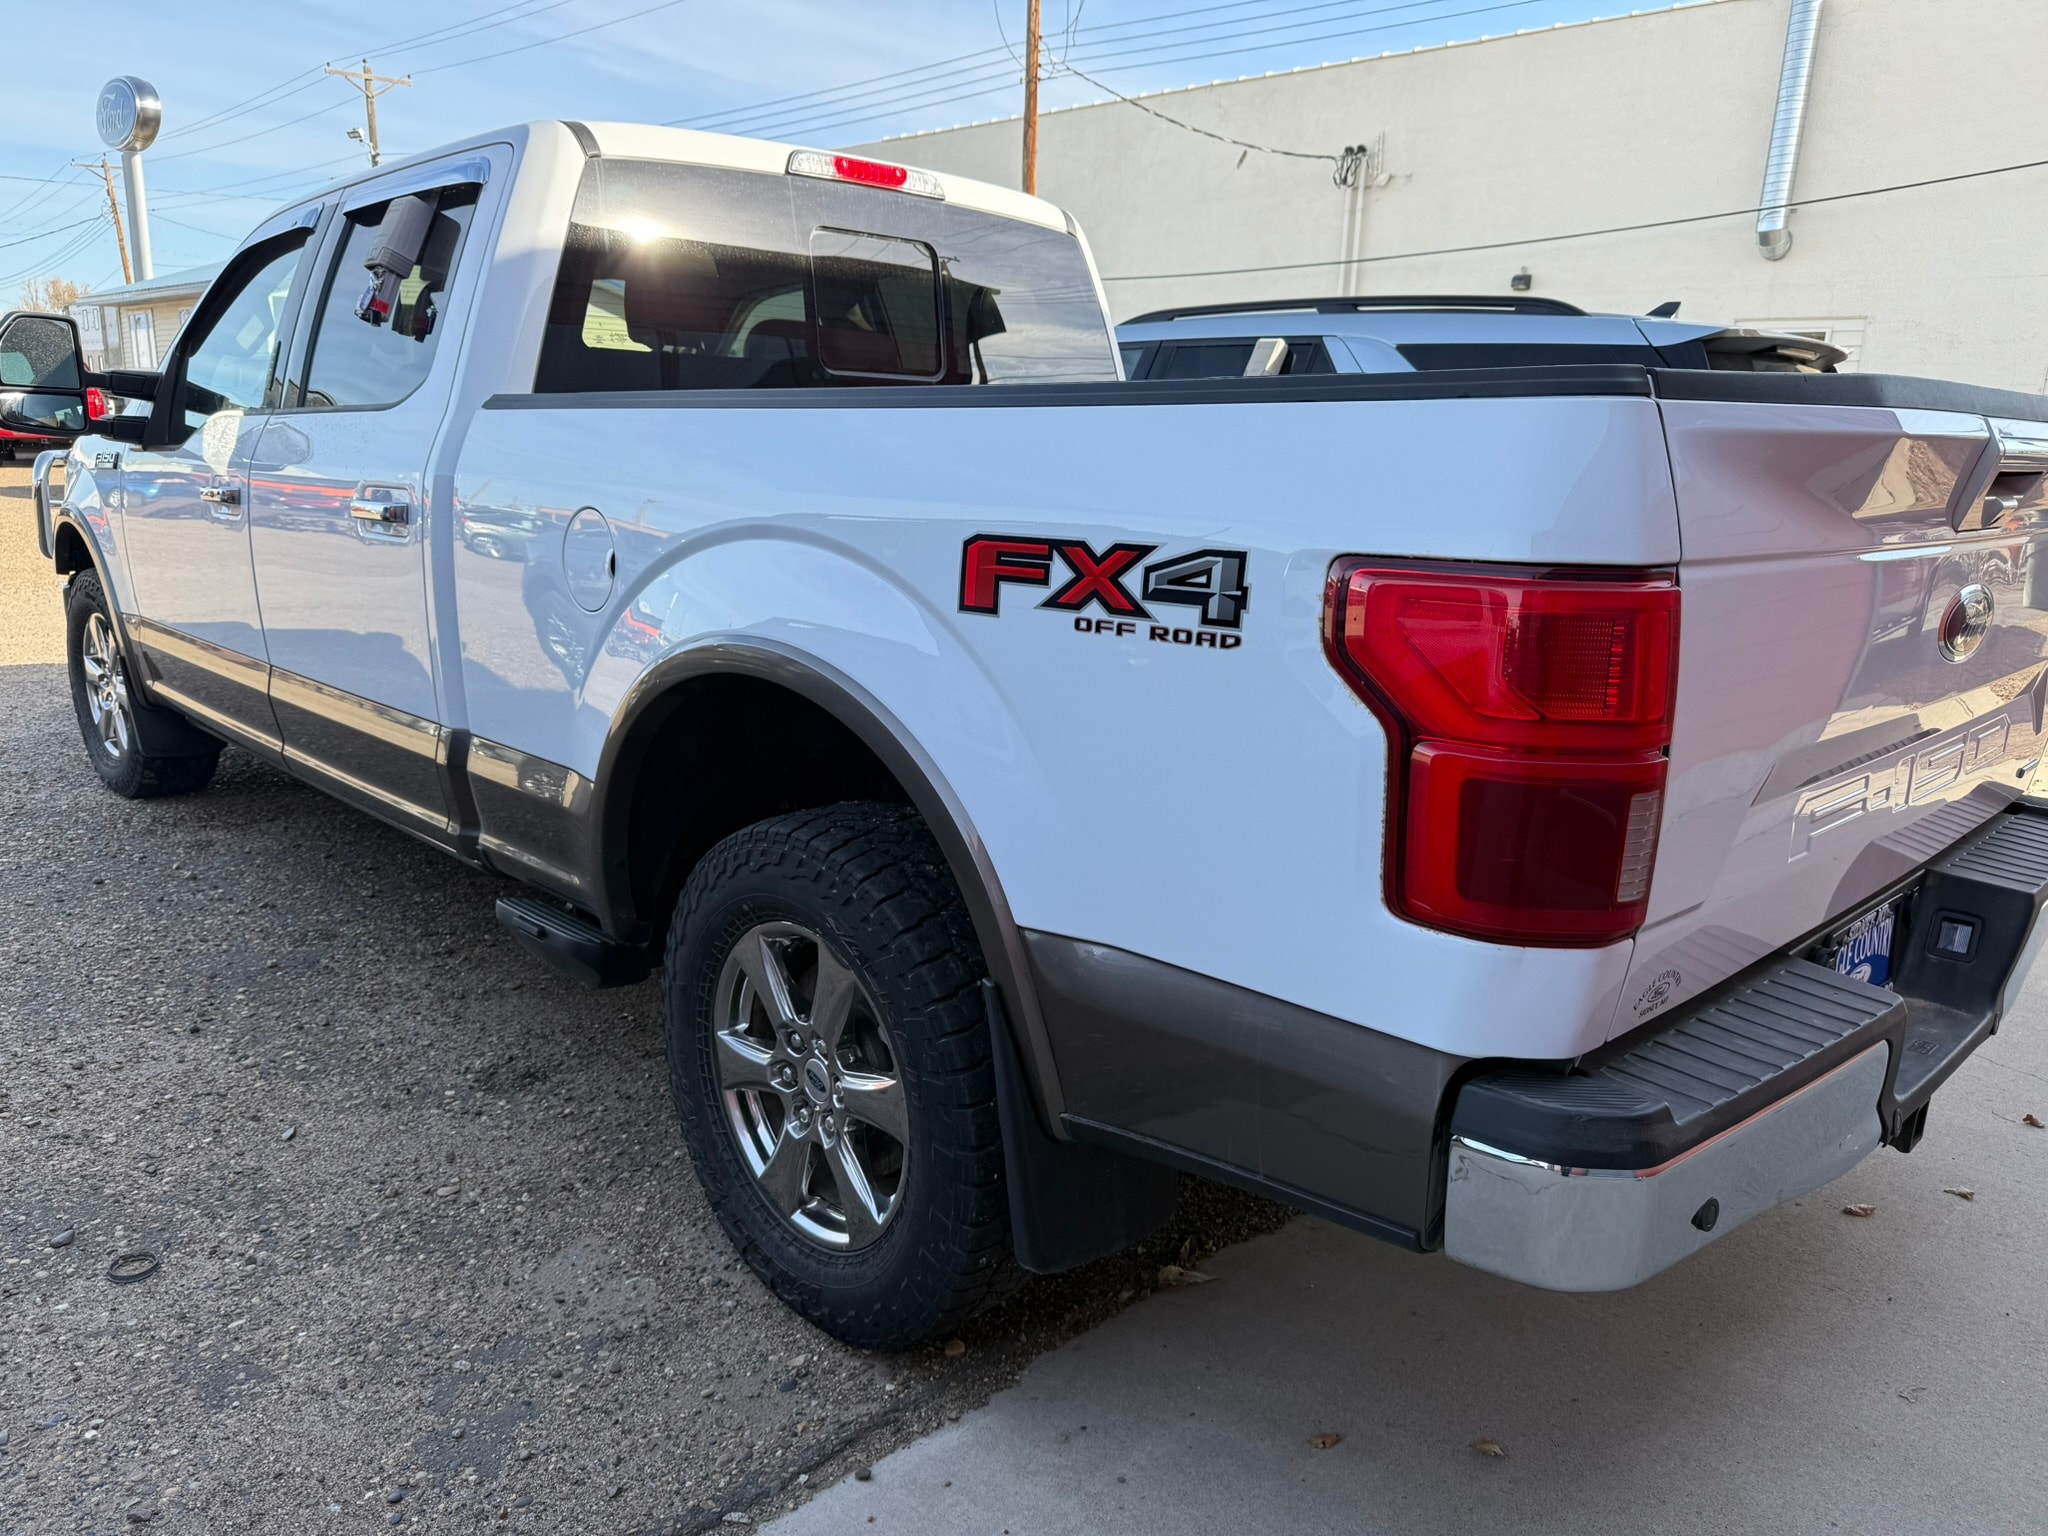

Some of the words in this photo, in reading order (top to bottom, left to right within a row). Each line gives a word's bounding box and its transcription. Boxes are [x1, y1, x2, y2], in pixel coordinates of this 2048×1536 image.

[101, 91, 125, 134] Ford
[957, 531, 1252, 632] FX4
[1074, 616, 1137, 638] OFF
[1149, 624, 1243, 650] ROAD
[1788, 713, 2011, 864] F-150
[1836, 940, 1854, 975] GLE
[1854, 916, 1894, 964] COUNTRY
